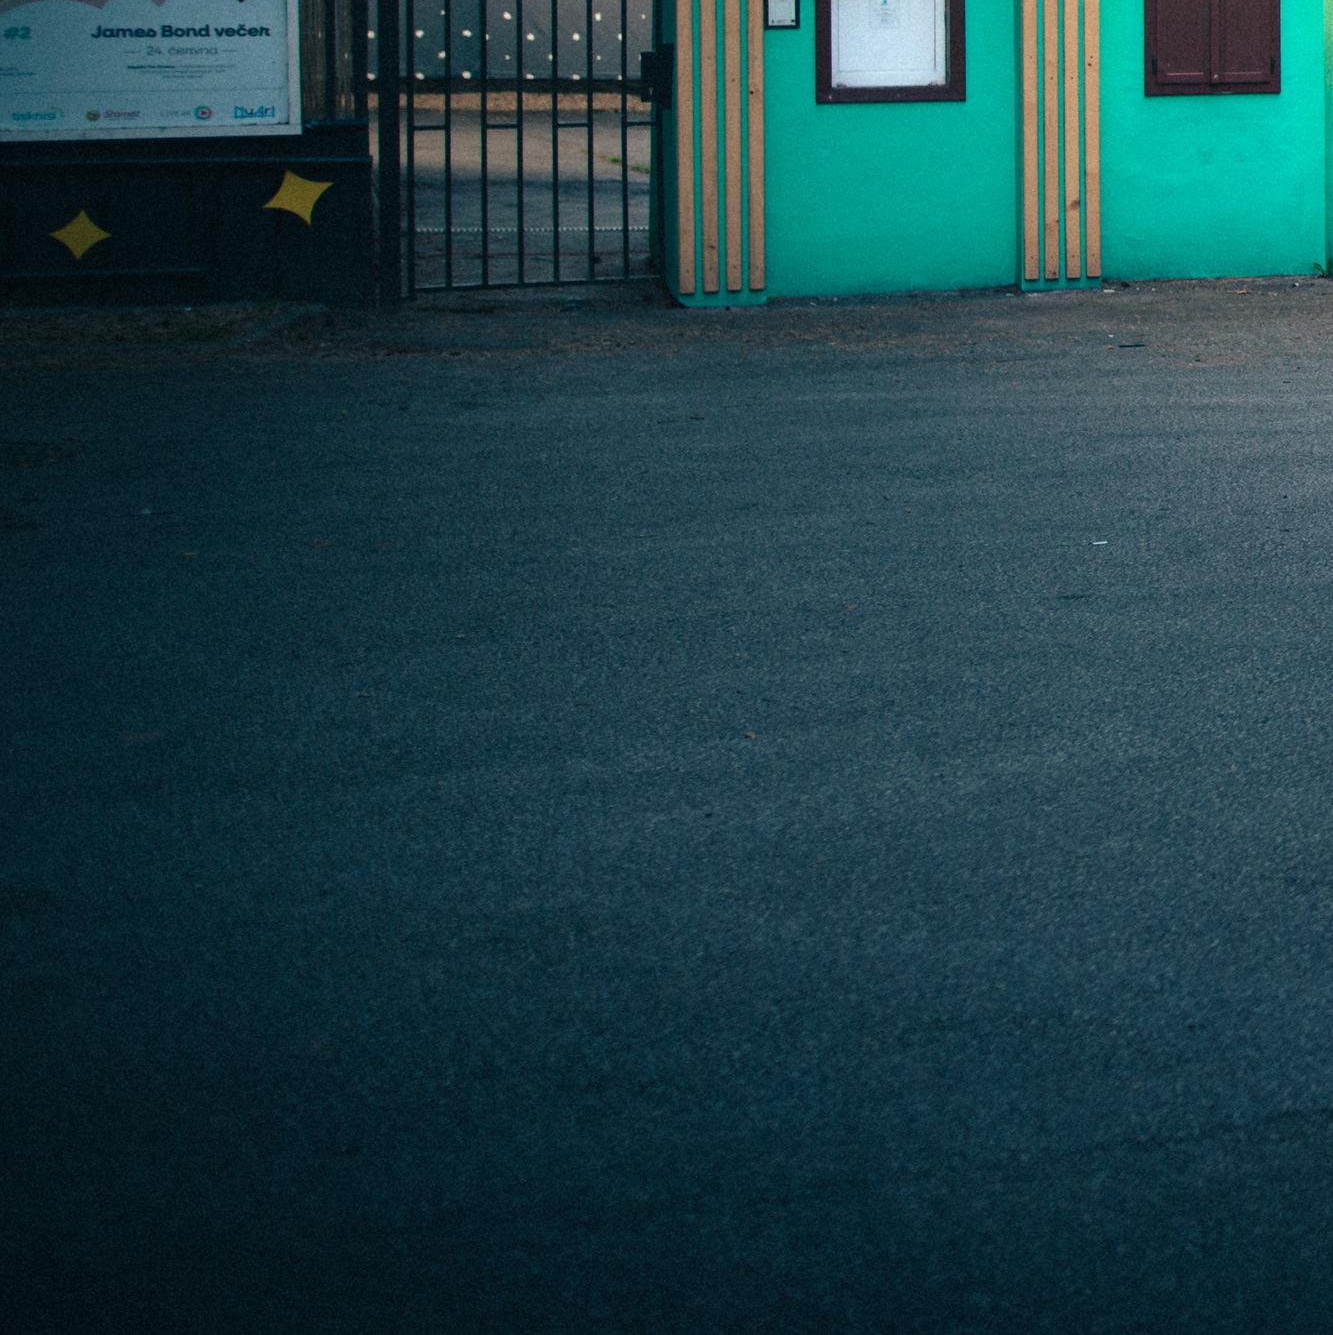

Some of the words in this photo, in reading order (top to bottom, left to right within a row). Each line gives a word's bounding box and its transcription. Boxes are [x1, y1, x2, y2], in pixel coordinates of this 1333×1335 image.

[91, 25, 157, 39] James
[160, 24, 210, 38] Bond
[214, 24, 271, 37] večer
